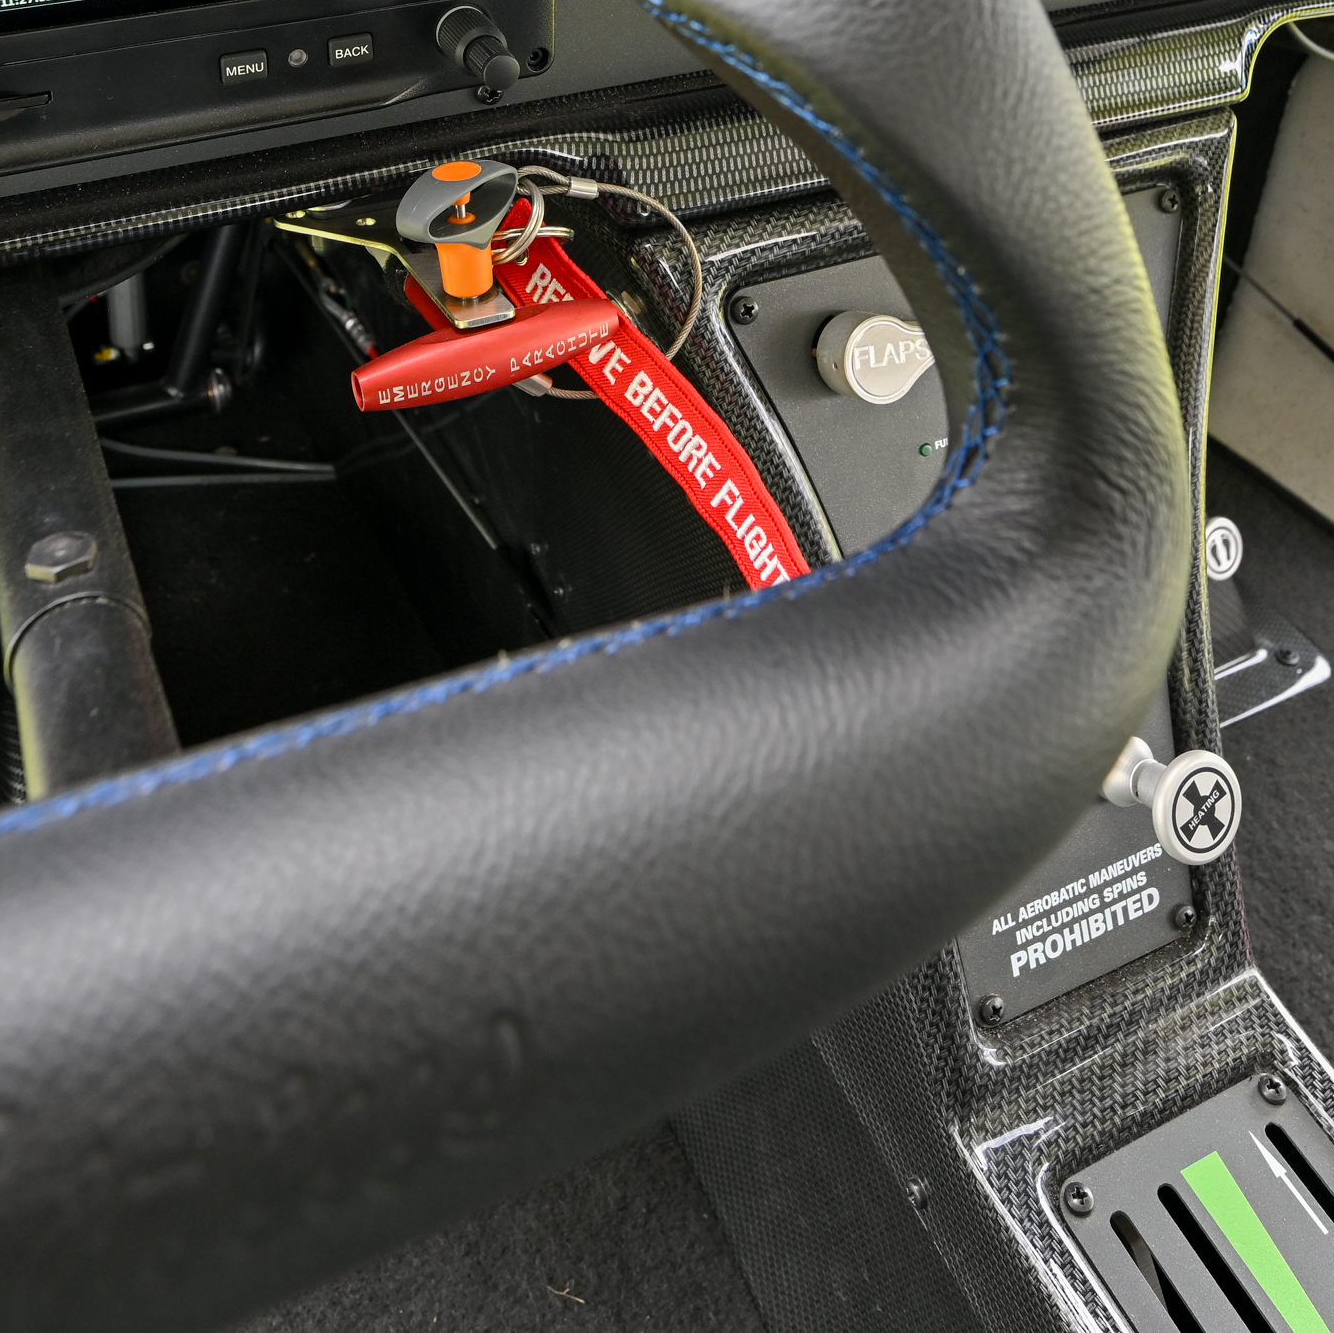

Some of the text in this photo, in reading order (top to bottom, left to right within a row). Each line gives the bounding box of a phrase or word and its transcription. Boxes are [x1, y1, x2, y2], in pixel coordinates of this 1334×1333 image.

[225, 61, 265, 78] MENU
[334, 43, 369, 60] BACK
[378, 321, 609, 405] EMERGENCY PARACHUTE
[853, 338, 931, 370] FLAPS
[624, 370, 791, 587] BEFORE FLIGHT
[1188, 789, 1220, 831] HEATING
[992, 842, 1163, 935] ALL AEROBATIC MANEUVERS
[1016, 871, 1147, 946] INCLUDING SPINS
[1010, 886, 1160, 978] PROHIBITED
